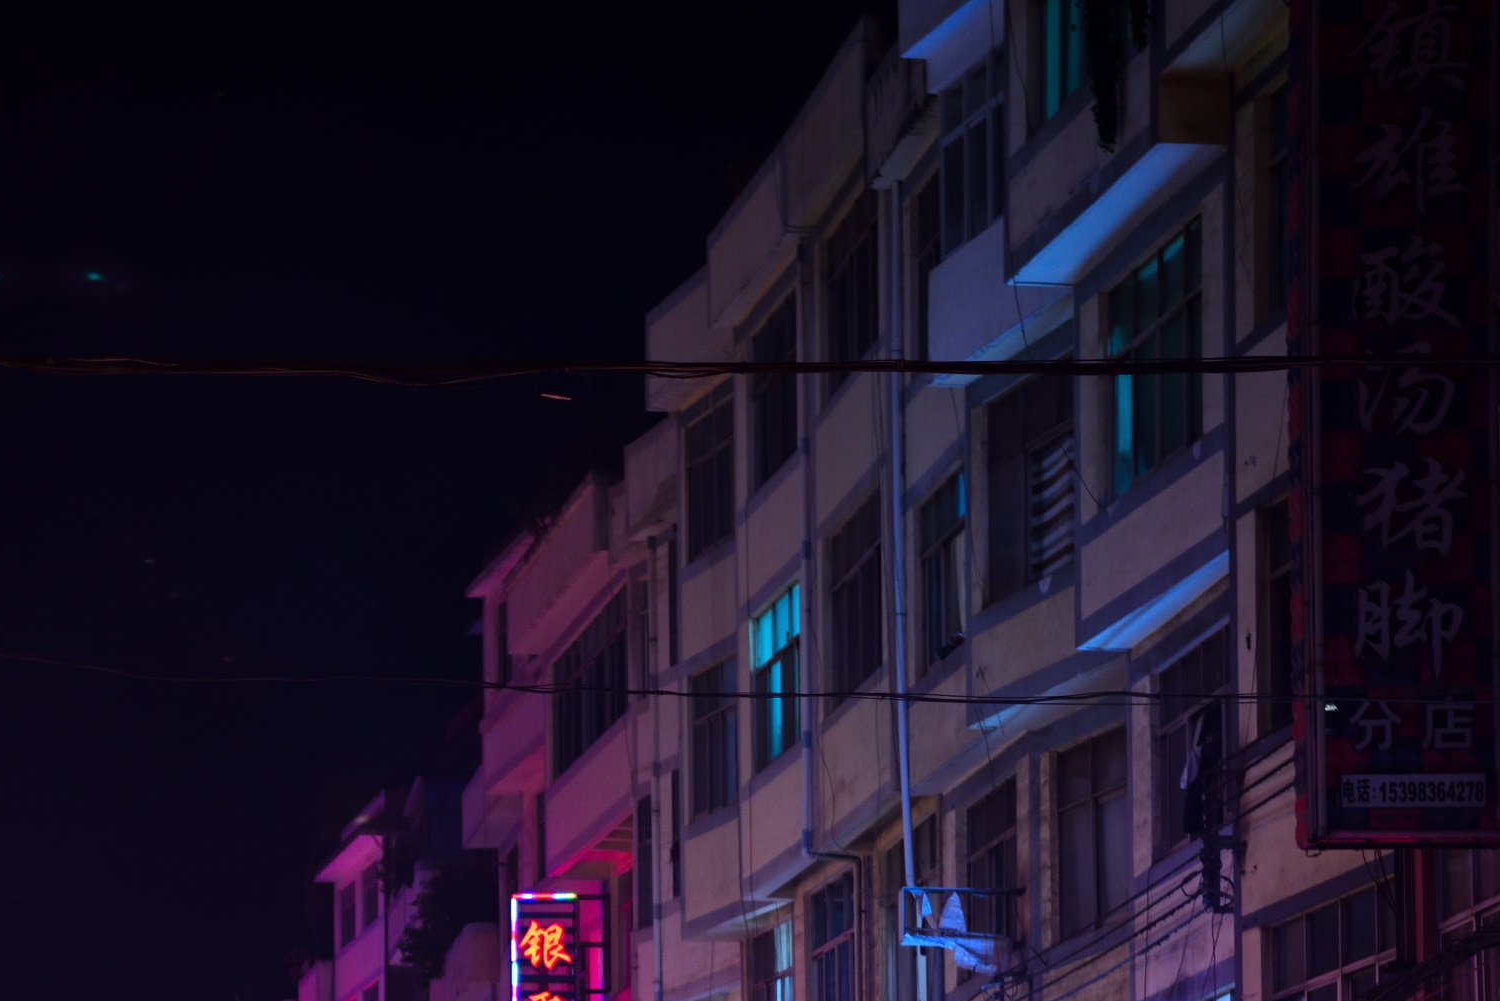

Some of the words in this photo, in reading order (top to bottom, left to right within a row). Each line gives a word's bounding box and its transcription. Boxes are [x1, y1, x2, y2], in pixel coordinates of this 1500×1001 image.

[1352, 0, 1473, 681] 镇雄酸汤猪脚
[1348, 697, 1475, 752] 分店
[1342, 776, 1486, 805] 电话:15398364278
